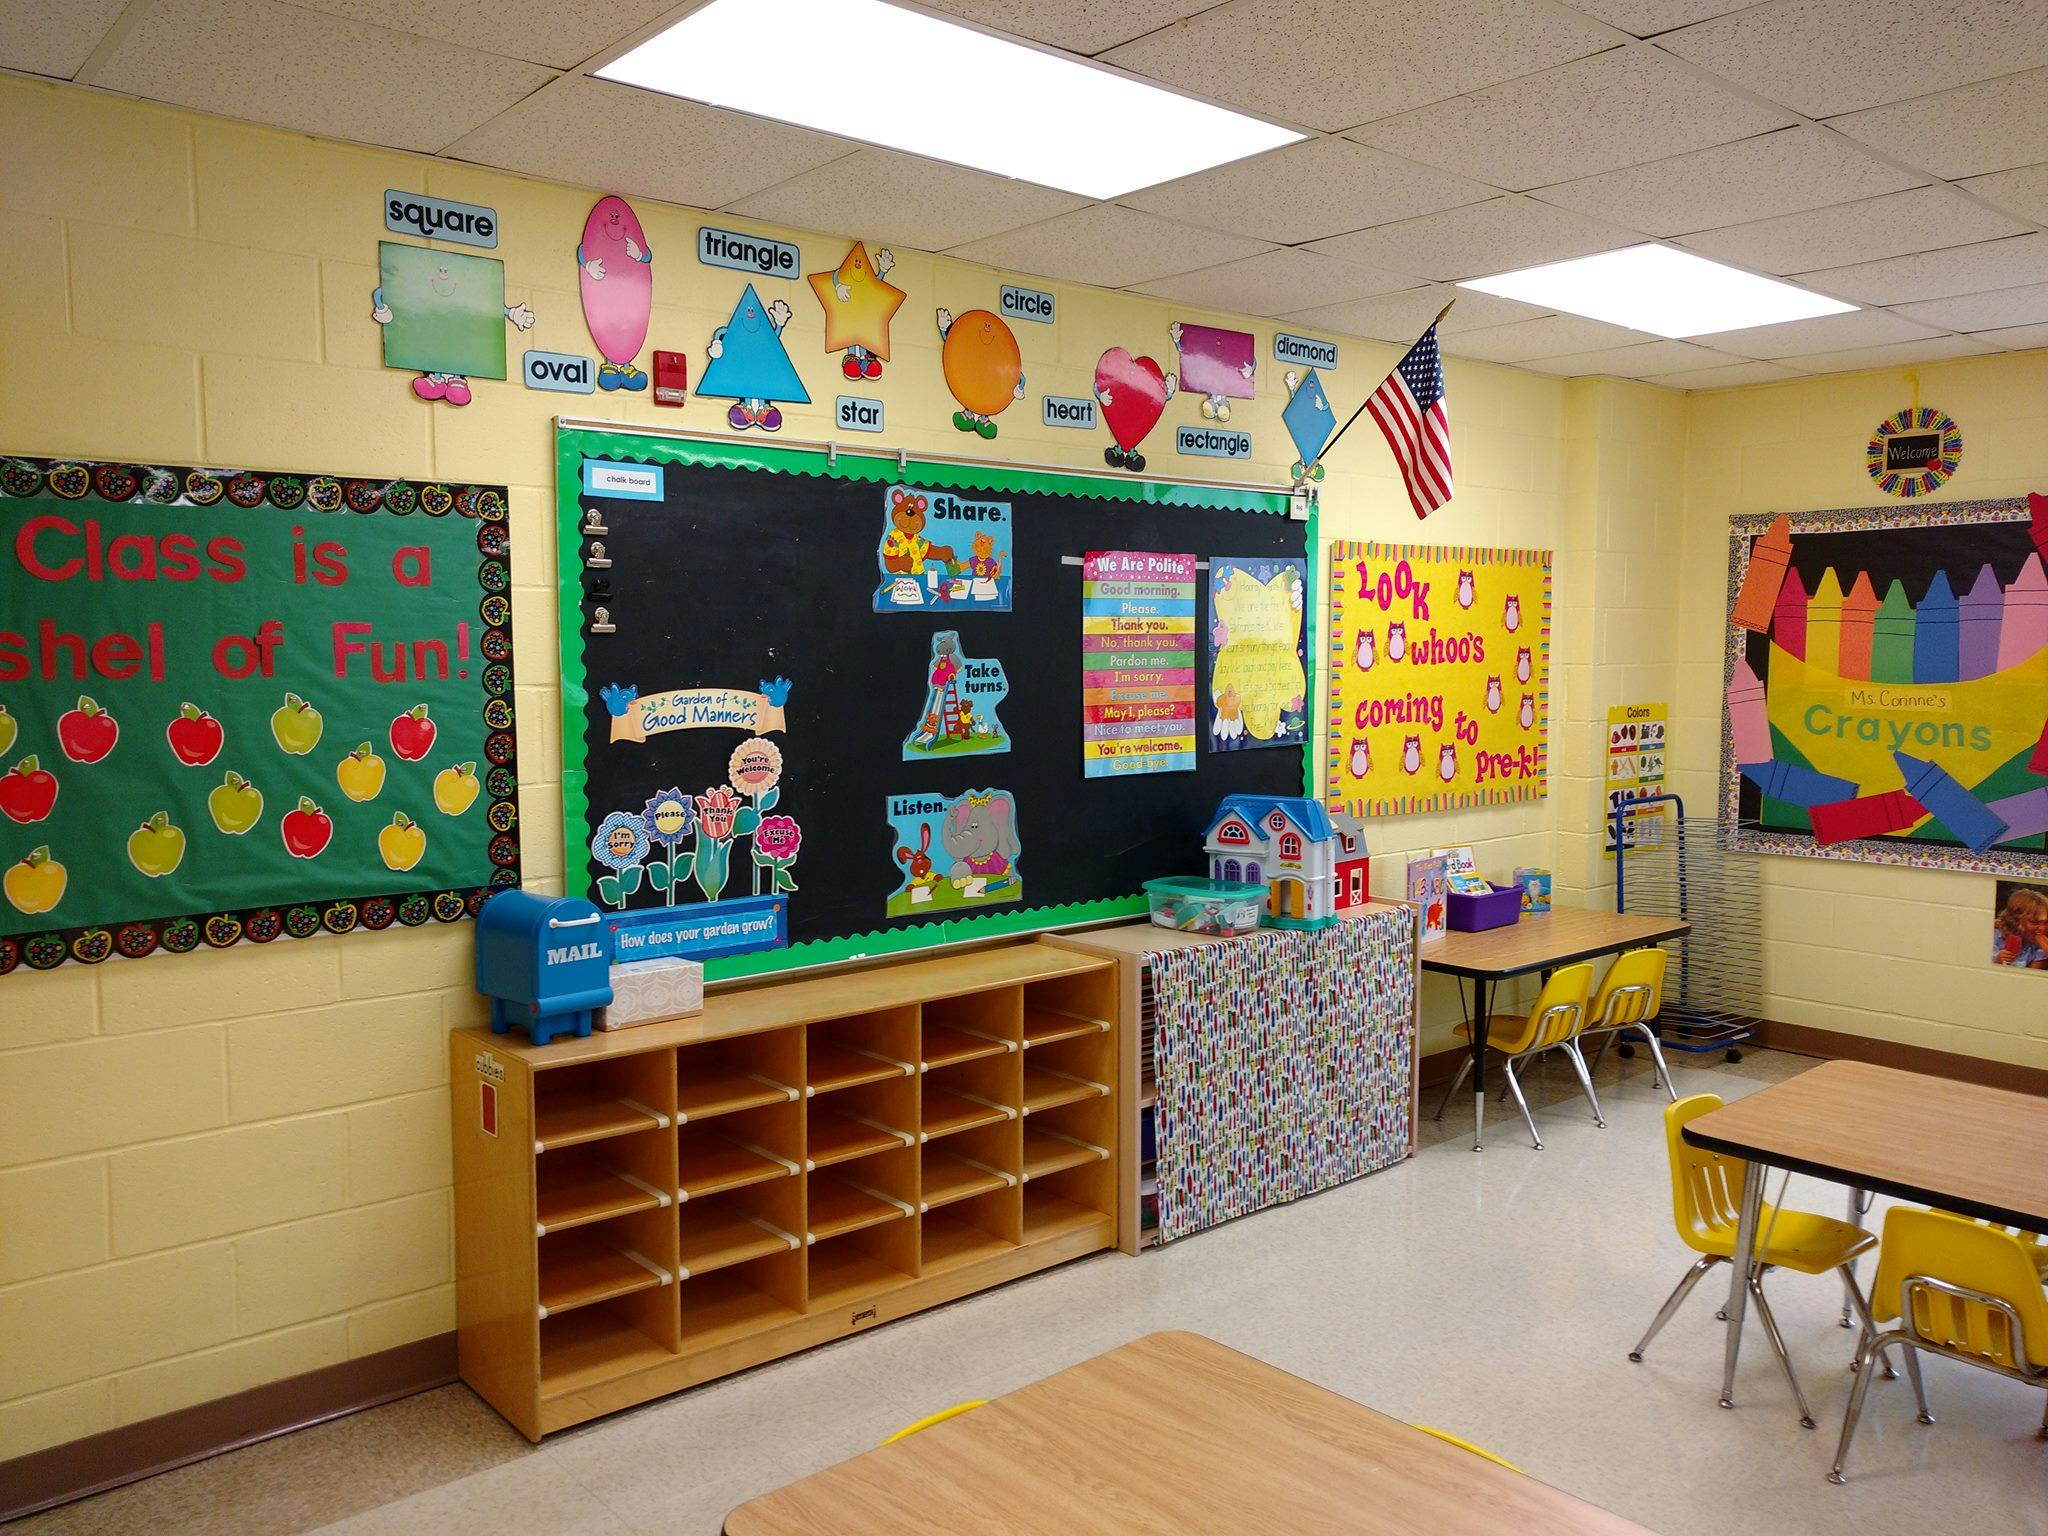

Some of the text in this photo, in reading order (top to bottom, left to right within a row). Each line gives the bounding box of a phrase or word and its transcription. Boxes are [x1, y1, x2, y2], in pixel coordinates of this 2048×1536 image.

[389, 199, 495, 236] square
[705, 231, 794, 271] triangle
[1002, 289, 1053, 317] circle
[1276, 339, 1337, 364] diamond
[530, 359, 588, 384] oval
[840, 401, 880, 427] star
[1046, 397, 1093, 423] heart
[1179, 431, 1250, 455] rectangle
[1888, 445, 1938, 460] Welcome
[606, 475, 651, 486] chalk board
[933, 498, 1007, 523] Share.
[16, 515, 432, 588] Class is a
[1097, 557, 1184, 575] We Are Polite
[1100, 583, 1180, 598] Good morning.
[1122, 601, 1159, 614] Please.
[1112, 618, 1169, 633] Thank you.
[1123, 636, 1152, 647] thank
[1156, 639, 1178, 650] you.
[1411, 628, 1485, 665] whoo's
[212, 620, 284, 680] of
[332, 621, 471, 684] Fun!
[1110, 653, 1169, 666] Pardon me.
[965, 664, 1000, 679] Take
[1114, 671, 1164, 684] I'm sorry.
[965, 679, 1006, 694] turns.
[672, 692, 728, 709] Garden of
[1110, 689, 1147, 701] Excuse
[1879, 690, 1946, 708] Corinne's
[642, 706, 758, 731] Good Manners
[1104, 707, 1127, 721] May
[1138, 704, 1176, 719] please?
[1355, 692, 1443, 732] coming
[1627, 706, 1650, 719] Colors
[1094, 724, 1185, 736] Nice to meet you.
[1455, 711, 1478, 745] to
[1804, 703, 1992, 751] Crayons
[1097, 739, 1183, 755] You're welcome.
[741, 755, 769, 764] You're
[1113, 758, 1169, 772] Good-bye.
[735, 766, 775, 776] Welcome
[655, 811, 686, 820] Please
[703, 807, 733, 816] Thank
[893, 799, 947, 817] Listen.
[709, 815, 727, 823] You
[764, 828, 795, 837] Excuse
[772, 836, 786, 845] Me
[1457, 857, 1473, 869] Book
[620, 915, 774, 949] How does your garden grow?
[547, 942, 603, 967] MAIL
